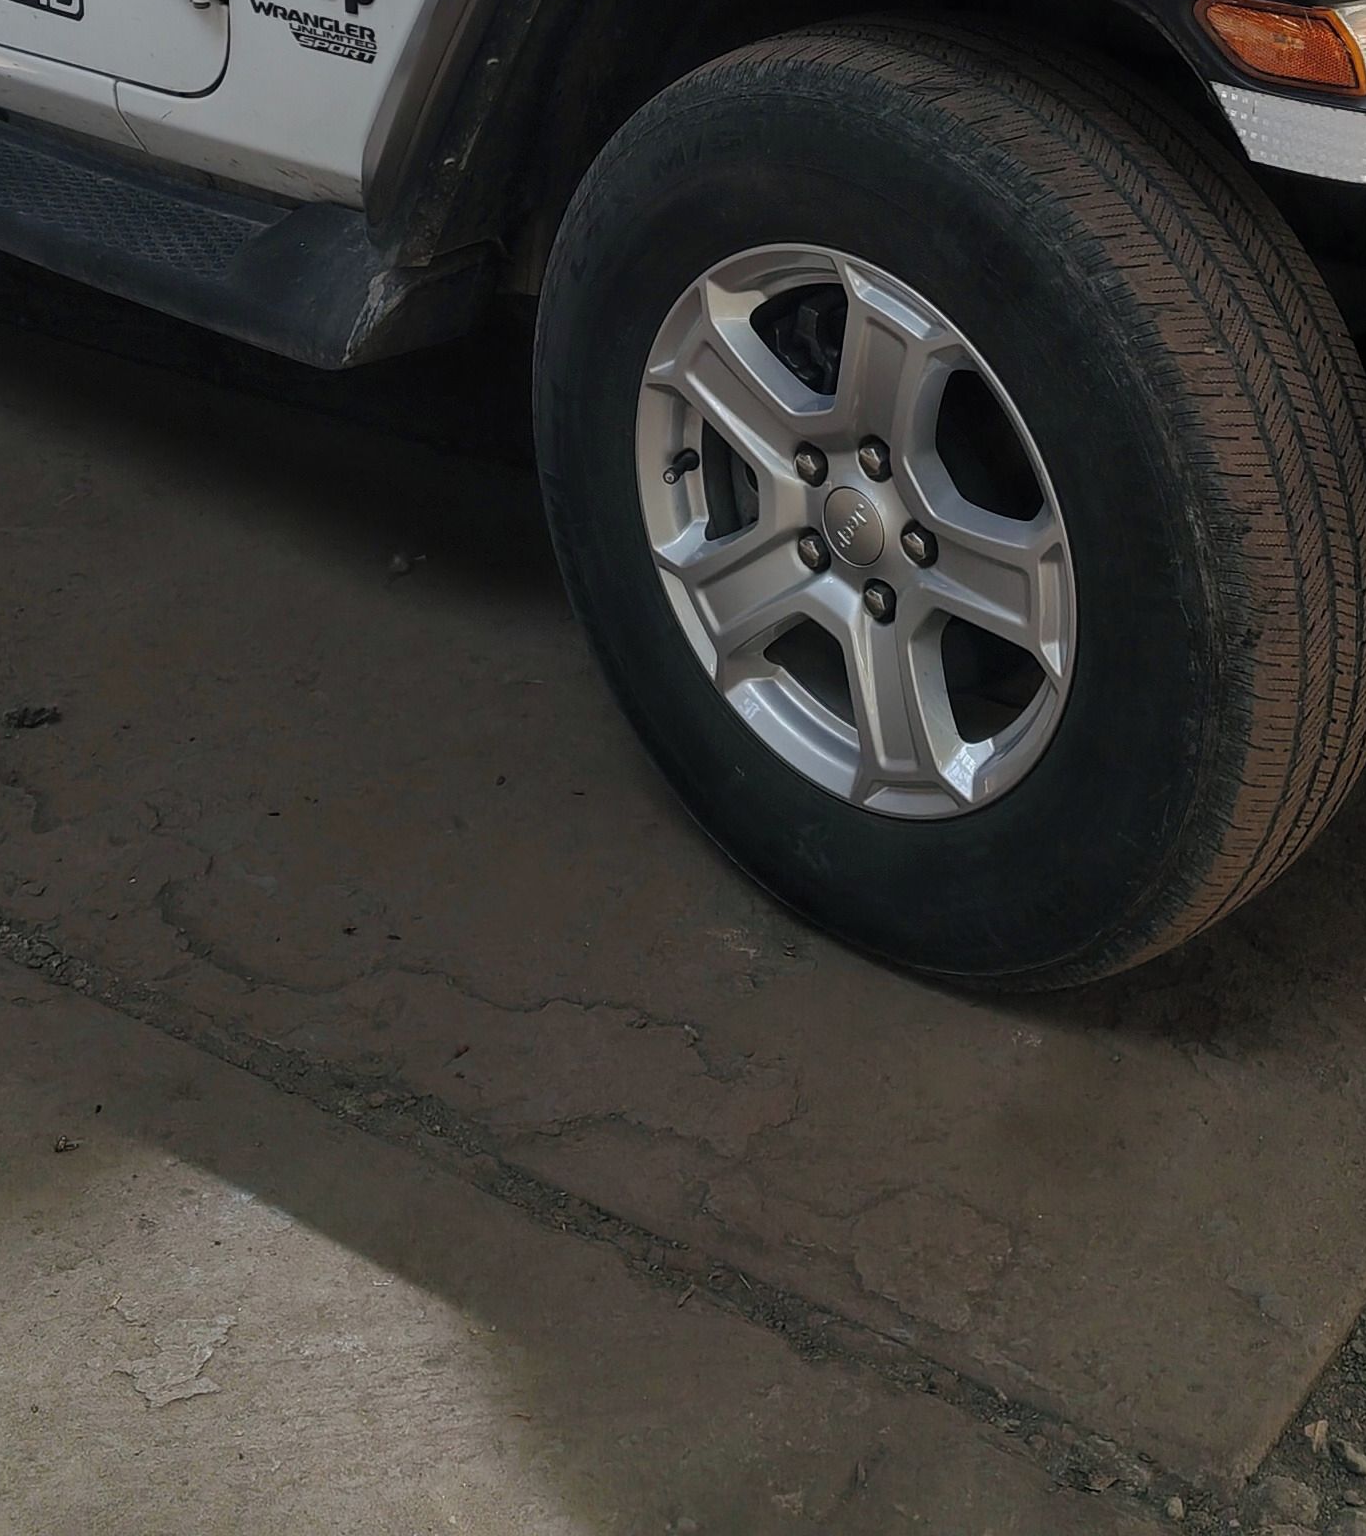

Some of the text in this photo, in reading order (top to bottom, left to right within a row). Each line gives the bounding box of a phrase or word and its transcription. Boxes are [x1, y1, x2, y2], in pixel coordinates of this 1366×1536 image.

[289, 22, 378, 51] UNLIMITED
[294, 36, 376, 62] SPORT
[836, 503, 867, 548] Jeep
